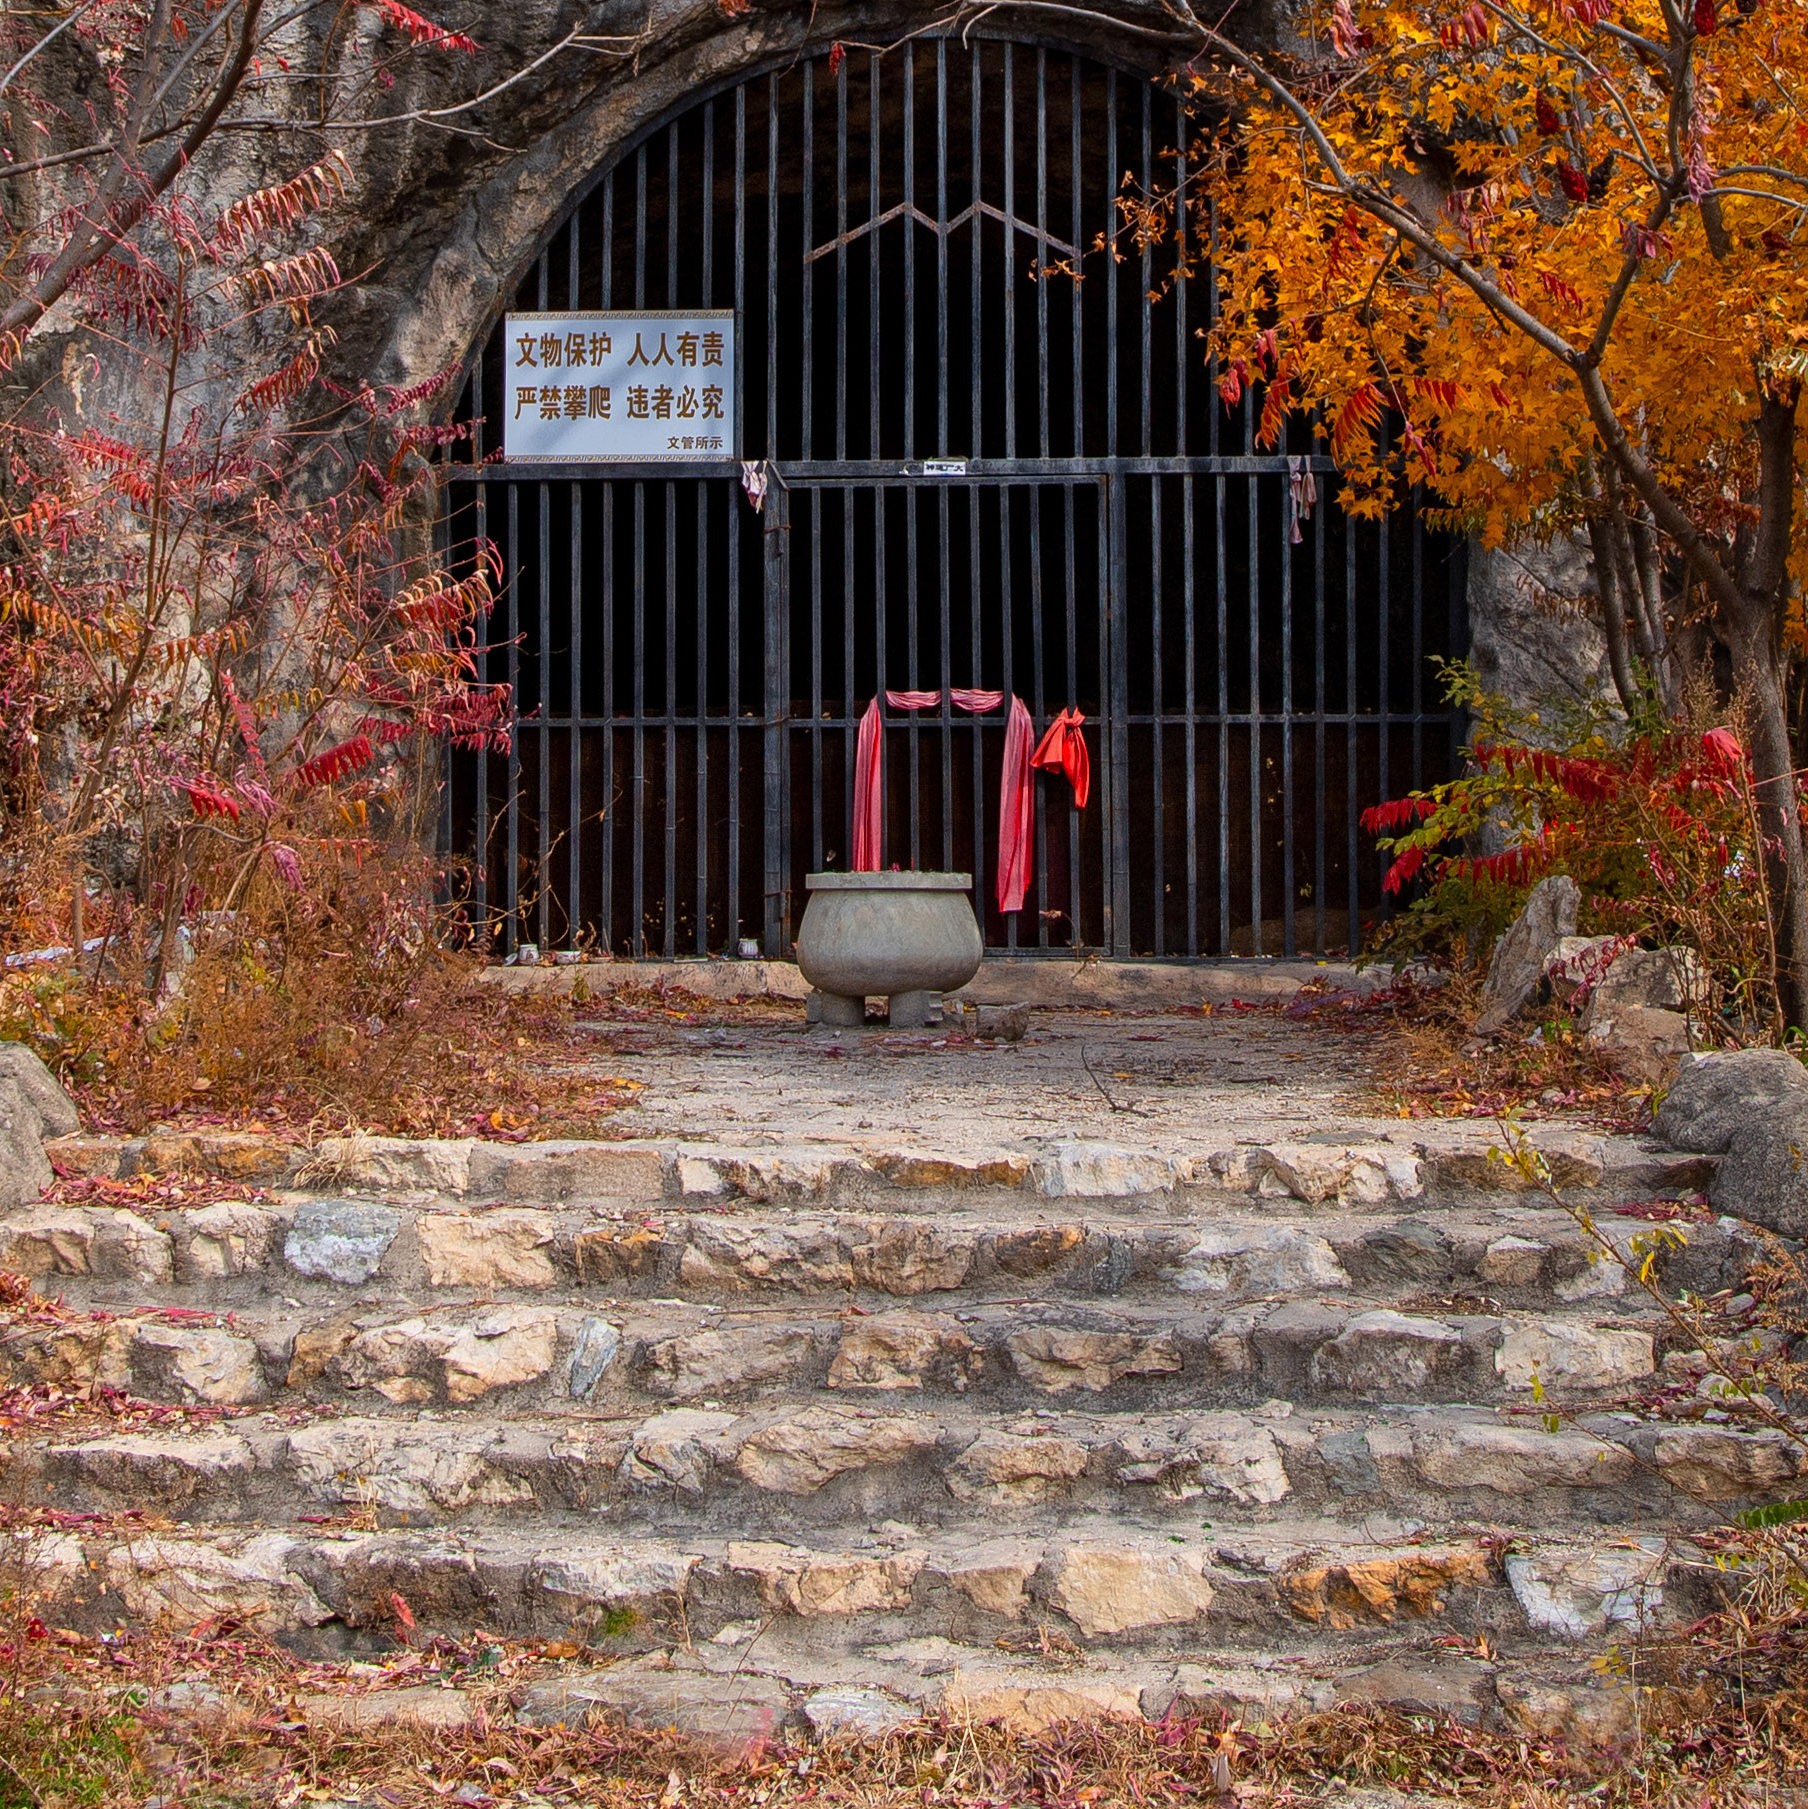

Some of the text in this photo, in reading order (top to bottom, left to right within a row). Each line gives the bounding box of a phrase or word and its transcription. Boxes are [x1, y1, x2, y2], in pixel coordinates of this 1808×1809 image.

[515, 331, 724, 367] 文物保护 人人有责
[514, 384, 725, 421] 严禁攀爬 违者必究
[667, 436, 723, 450] 文管所示
